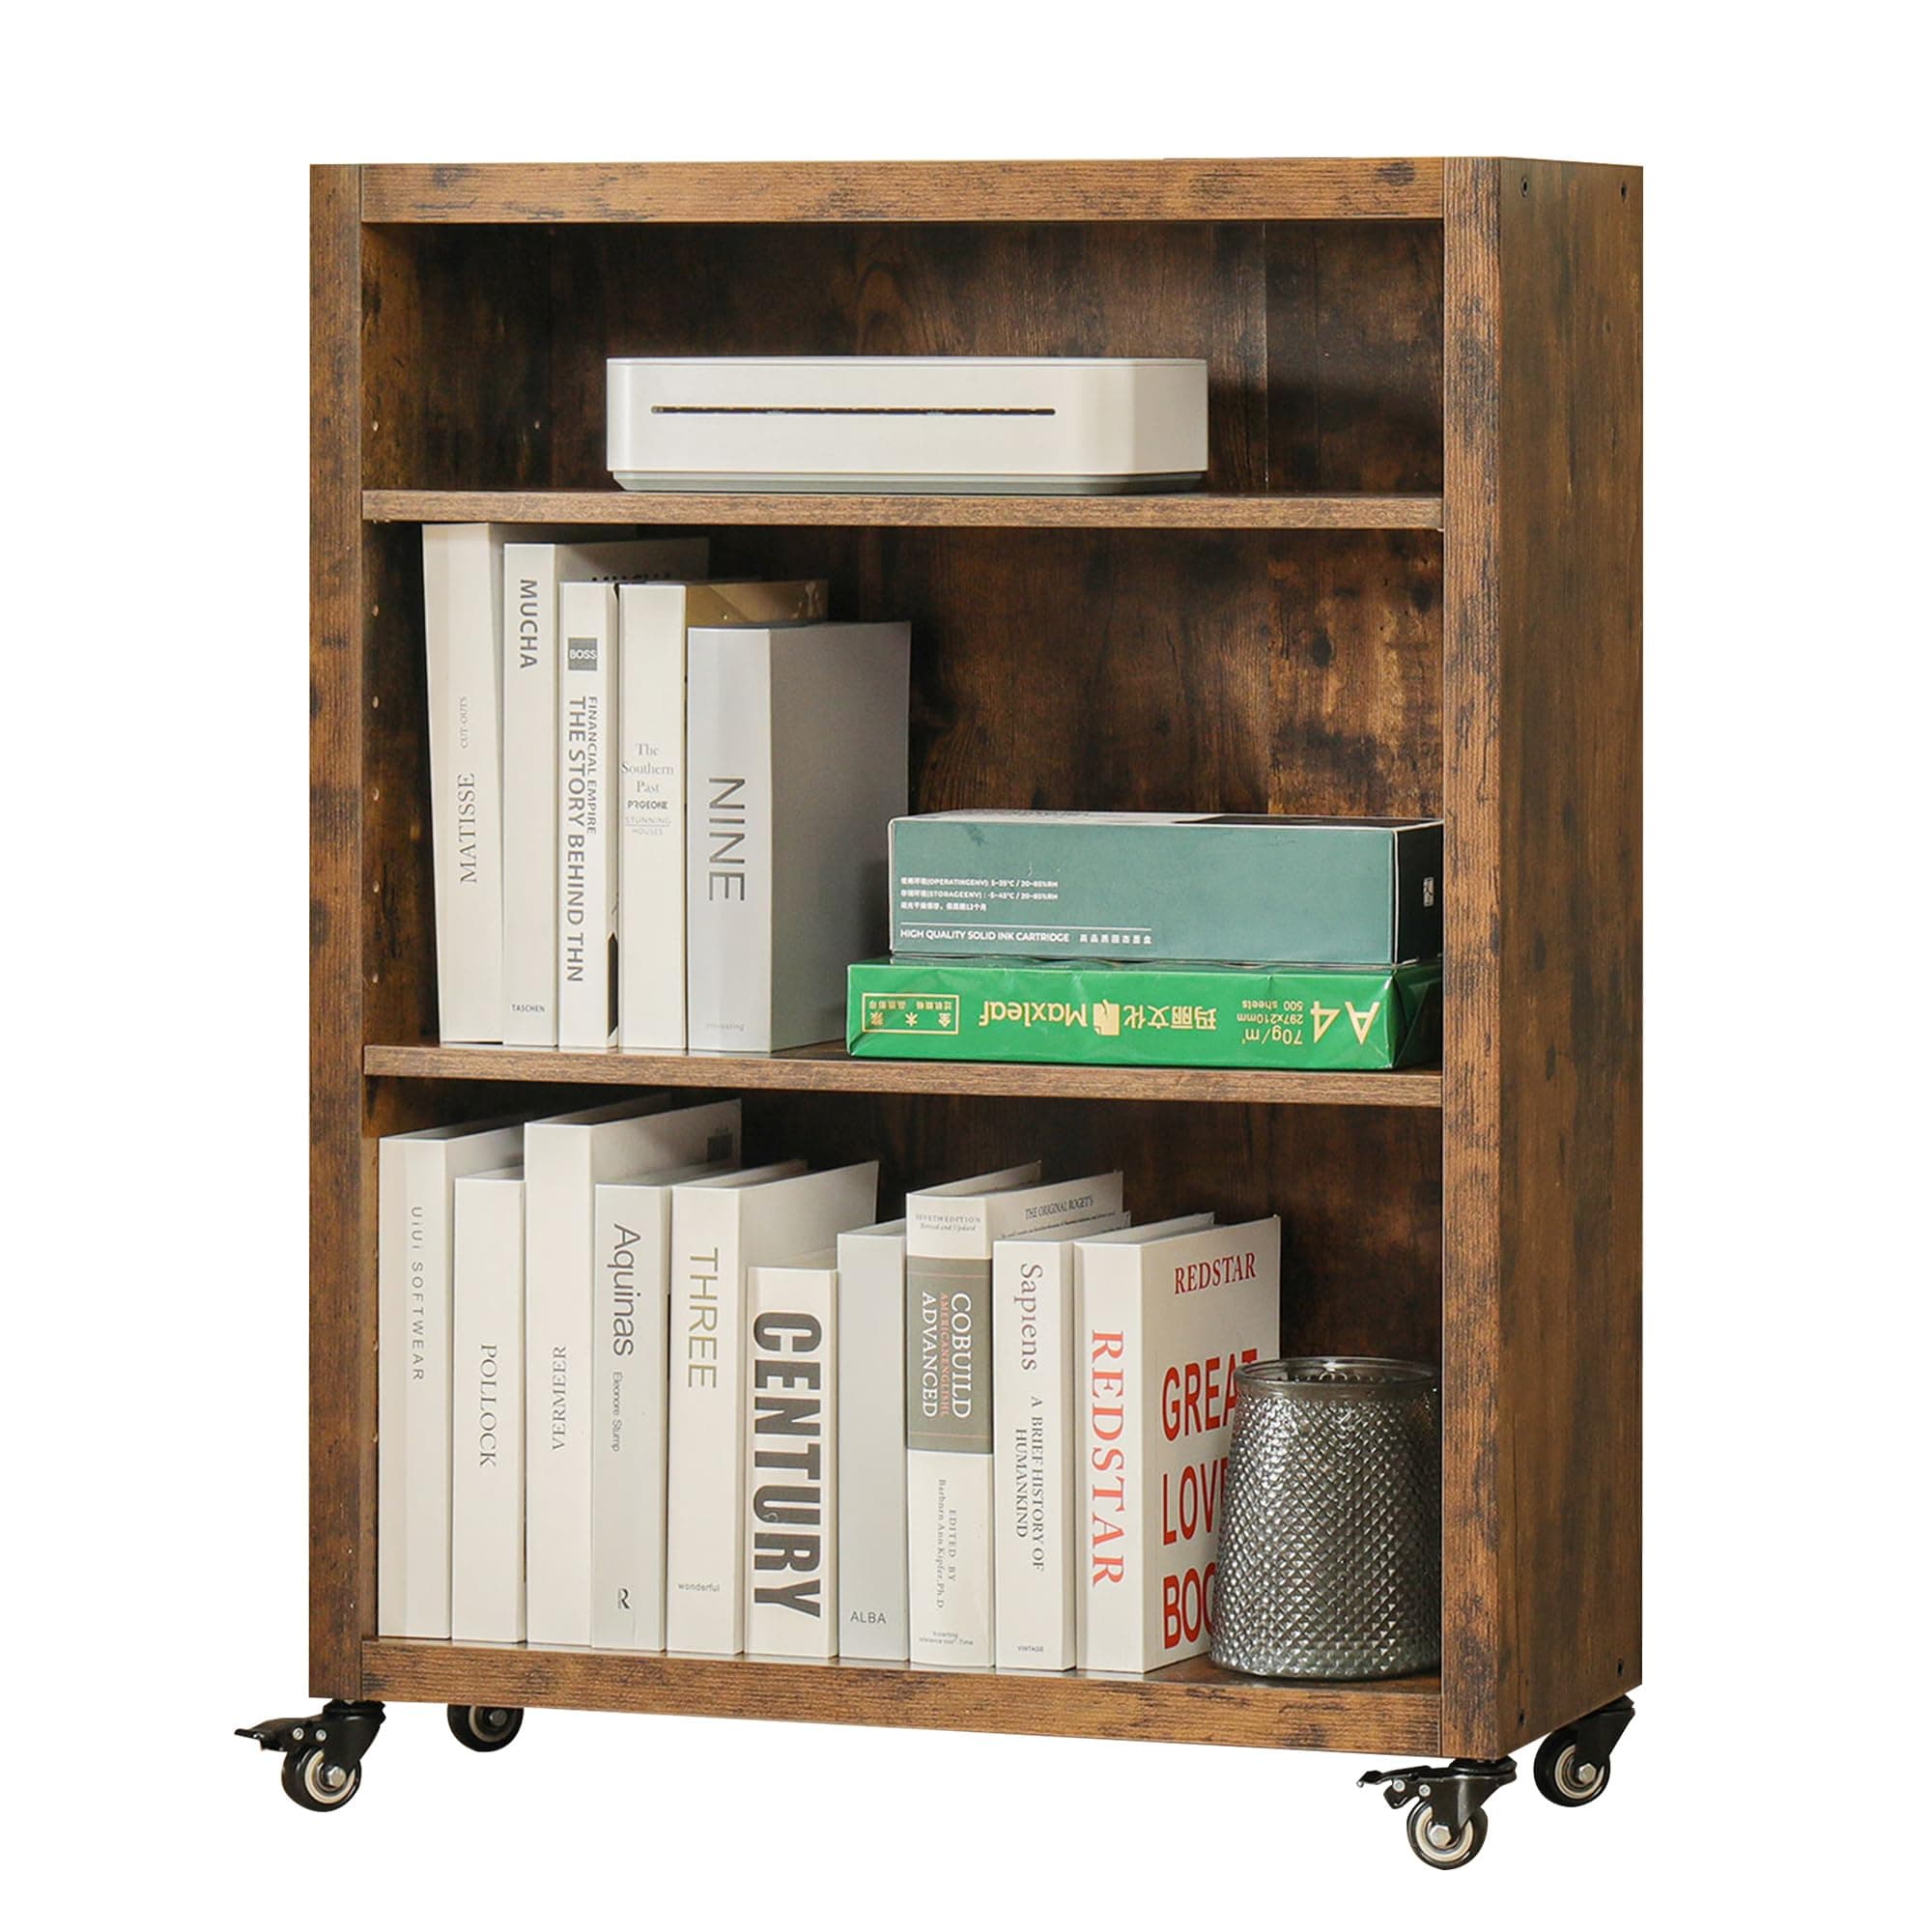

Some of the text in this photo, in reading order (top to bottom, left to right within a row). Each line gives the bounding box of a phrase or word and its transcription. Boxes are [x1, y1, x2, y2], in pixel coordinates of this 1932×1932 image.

[520, 580, 538, 668] MUCHA
[570, 648, 598, 661] BOSS
[587, 696, 597, 834] FINANCIAL EMPIRE
[458, 774, 476, 882] MATISSE
[567, 696, 585, 981] THE STORY BEHIND THN
[709, 779, 745, 900] NINE
[900, 929, 1069, 943] HIGH QUALITY SOLID INK CARTRIDGE
[977, 1000, 1088, 1028] Maxleaf
[1123, 1005, 1218, 1031] 玛丽文化
[1236, 1012, 1303, 1027] 297x210mm
[1240, 999, 1303, 1013] 500 sheets
[1310, 999, 1380, 1044] A4
[412, 1262, 425, 1379] SOFTWEAR
[607, 1224, 640, 1355] Aquinas
[688, 1247, 718, 1388] THREE
[1014, 1264, 1042, 1370] Sapiens
[1176, 1252, 1256, 1293] REDSTAR
[480, 1346, 497, 1465] POLLOCK
[553, 1347, 566, 1449] VERMEER
[923, 1292, 939, 1418] ADVANCED
[952, 1293, 973, 1418] COBUILD
[753, 1313, 822, 1618] CENTURY
[1015, 1430, 1028, 1537] HUMANKIND
[1032, 1397, 1043, 1571] A BRIEF HISTORY OF
[1092, 1330, 1124, 1587] REDSTAR
[678, 1583, 720, 1592] wonderful
[850, 1611, 886, 1623] ALBA
